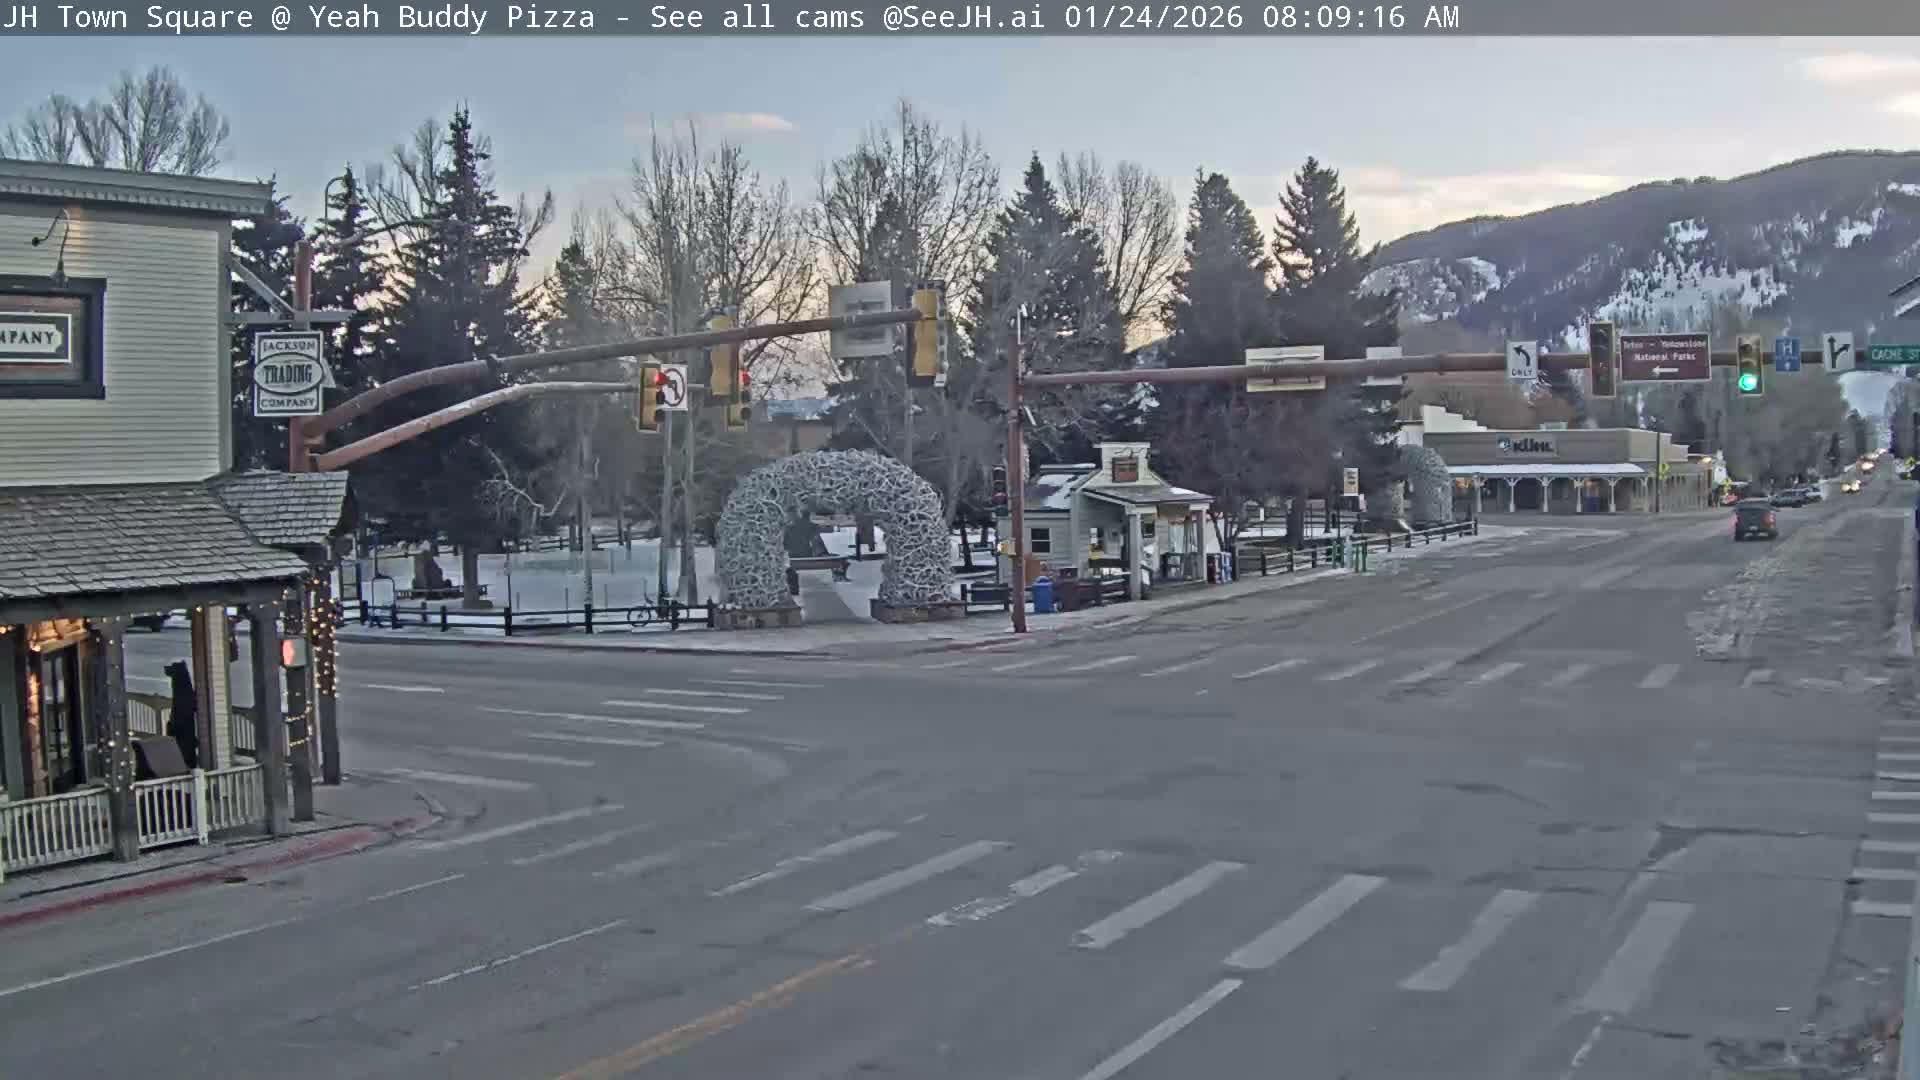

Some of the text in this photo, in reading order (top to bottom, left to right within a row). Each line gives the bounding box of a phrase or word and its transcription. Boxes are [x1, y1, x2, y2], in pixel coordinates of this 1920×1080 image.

[263, 341, 316, 352] JACKSON
[1871, 348, 1902, 360] CACHE
[263, 364, 312, 384] TRADING
[1511, 368, 1533, 376] ONLY
[261, 398, 315, 408] COMPANY
